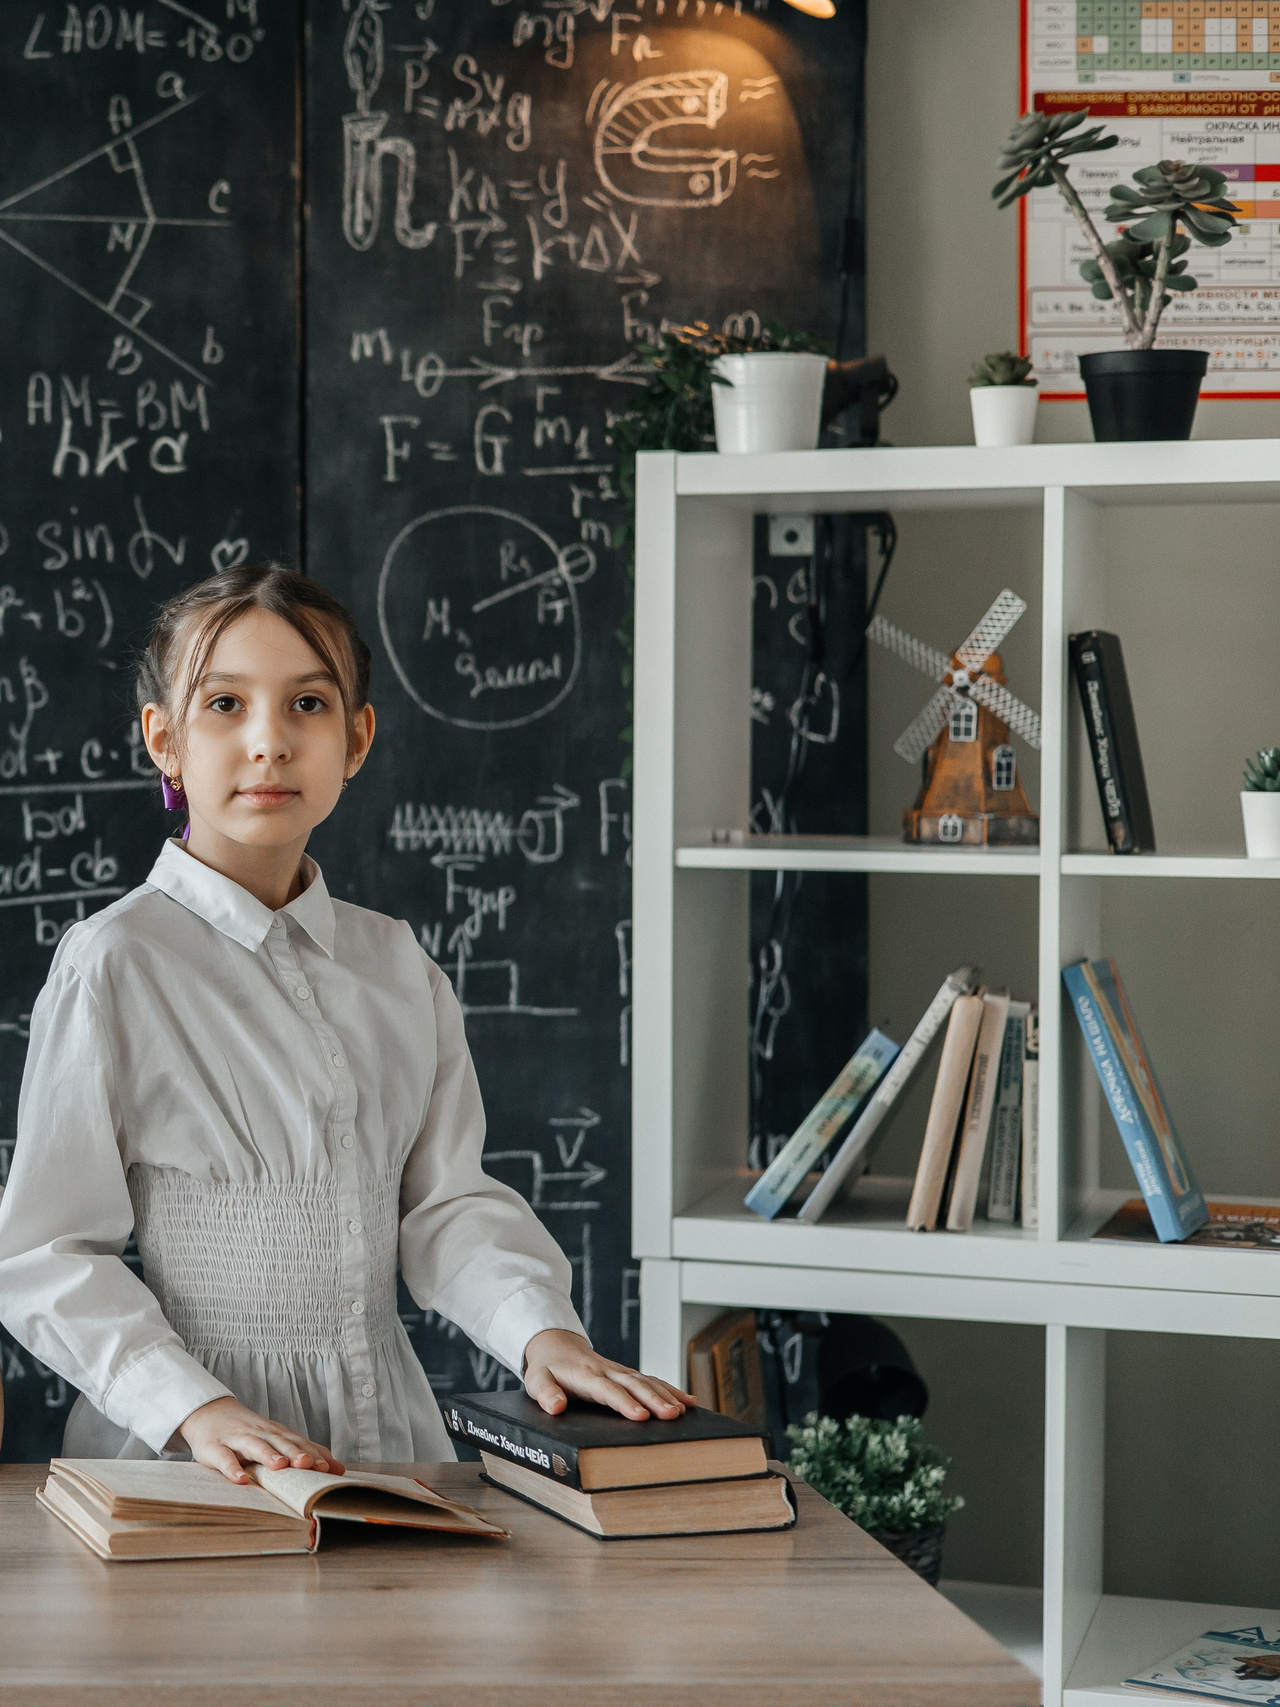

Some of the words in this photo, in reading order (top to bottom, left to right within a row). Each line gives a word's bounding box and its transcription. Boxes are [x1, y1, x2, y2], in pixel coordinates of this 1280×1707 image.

[1127, 92, 1187, 103] ОКРАСКИ
[1239, 104, 1257, 115] ОТ
[1205, 121, 1259, 132] ОКРАСКА
[1263, 121, 1280, 132] ИН
[467, 1420, 500, 1446] Джеймс
[525, 1446, 550, 1469] ЧЕЙЗ
